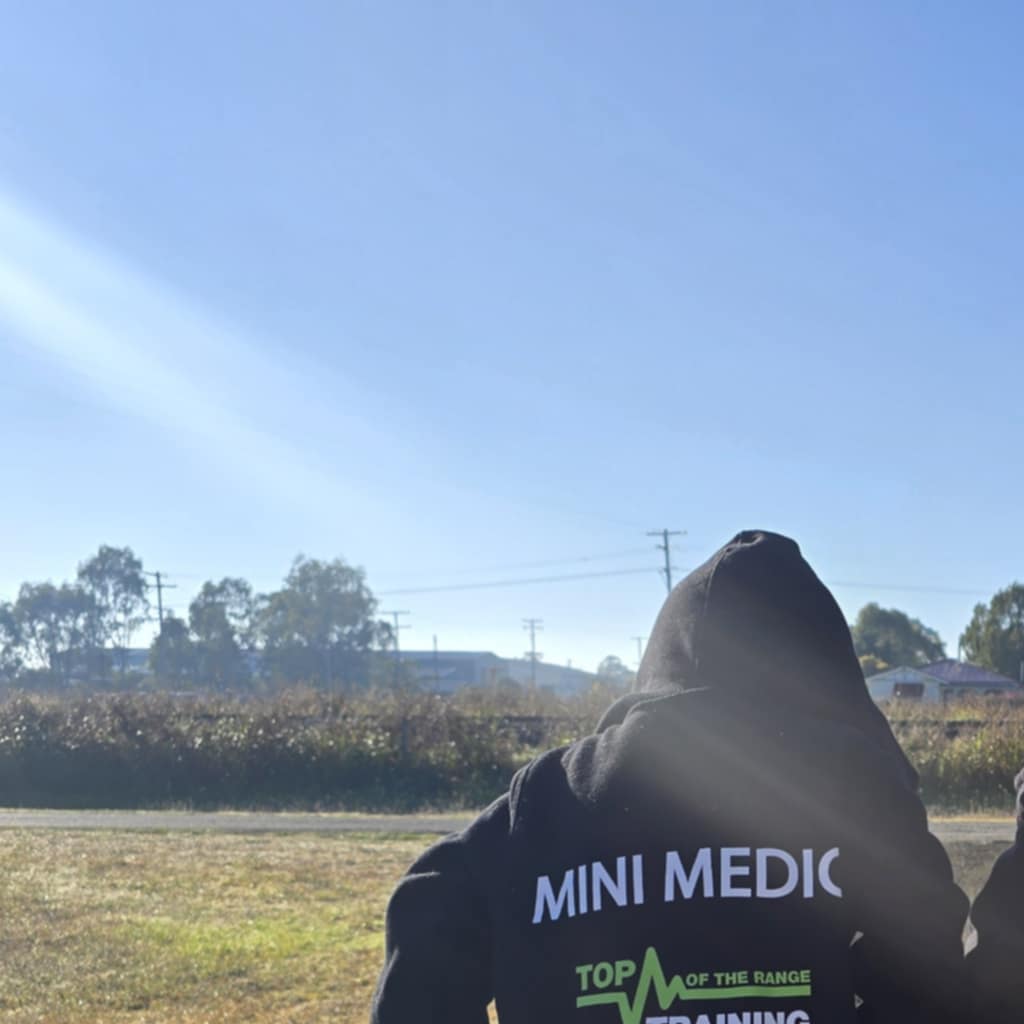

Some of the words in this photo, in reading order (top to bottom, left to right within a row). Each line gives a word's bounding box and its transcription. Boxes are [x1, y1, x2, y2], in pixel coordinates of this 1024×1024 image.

[532, 855, 644, 925] MINI
[664, 847, 843, 900] MEDIC
[576, 960, 636, 989] TOP
[686, 971, 709, 986] OF
[714, 971, 748, 986] THE
[753, 970, 811, 985] RANGE
